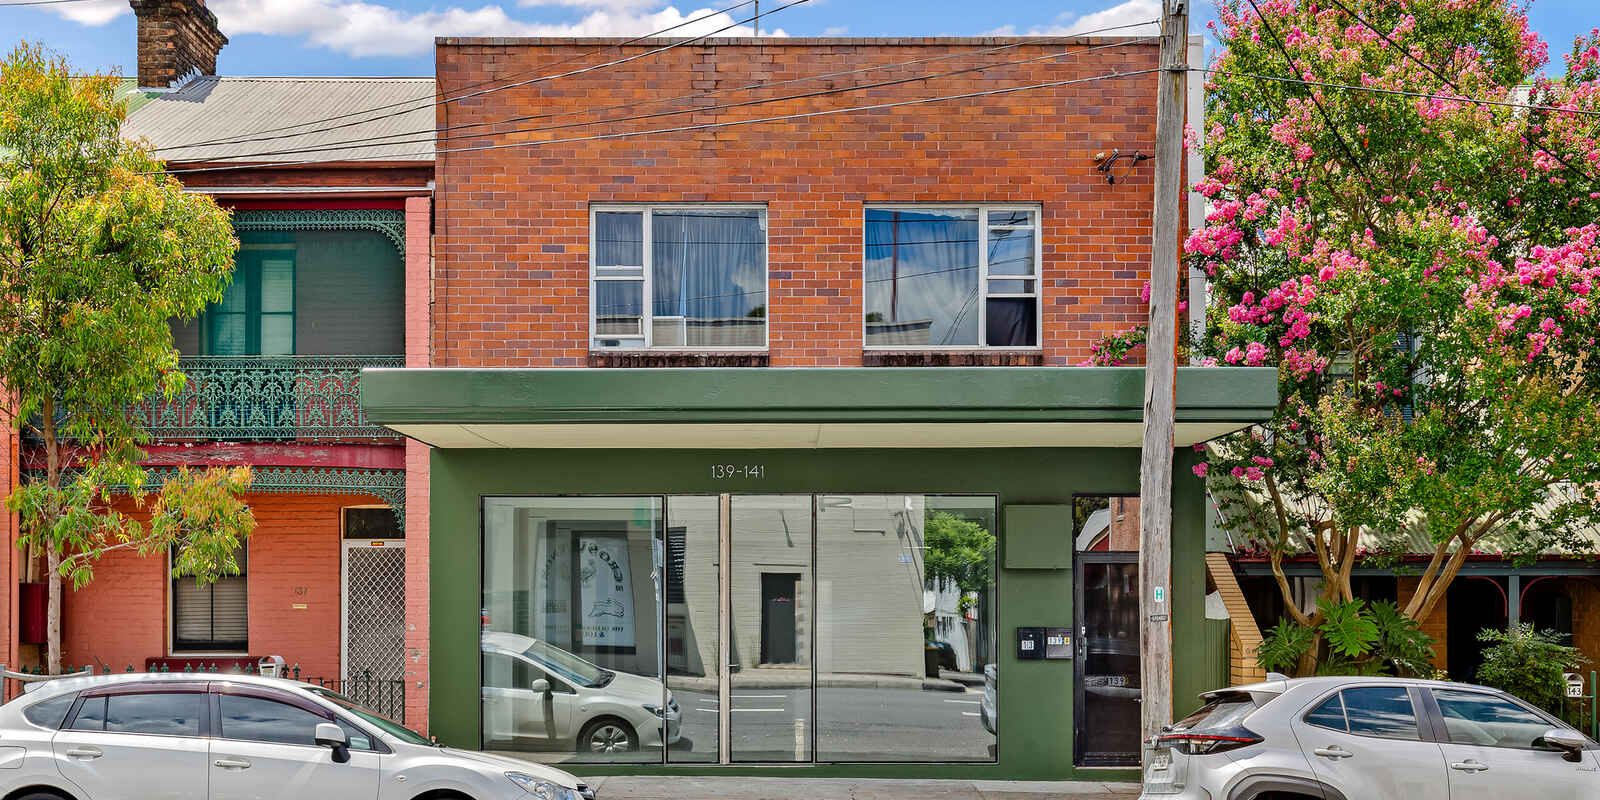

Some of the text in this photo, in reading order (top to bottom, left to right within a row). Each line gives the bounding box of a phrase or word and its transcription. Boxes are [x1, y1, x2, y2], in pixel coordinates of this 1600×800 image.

[711, 464, 764, 479] 139-141
[1155, 588, 1163, 600] H
[1567, 687, 1582, 696] 143
